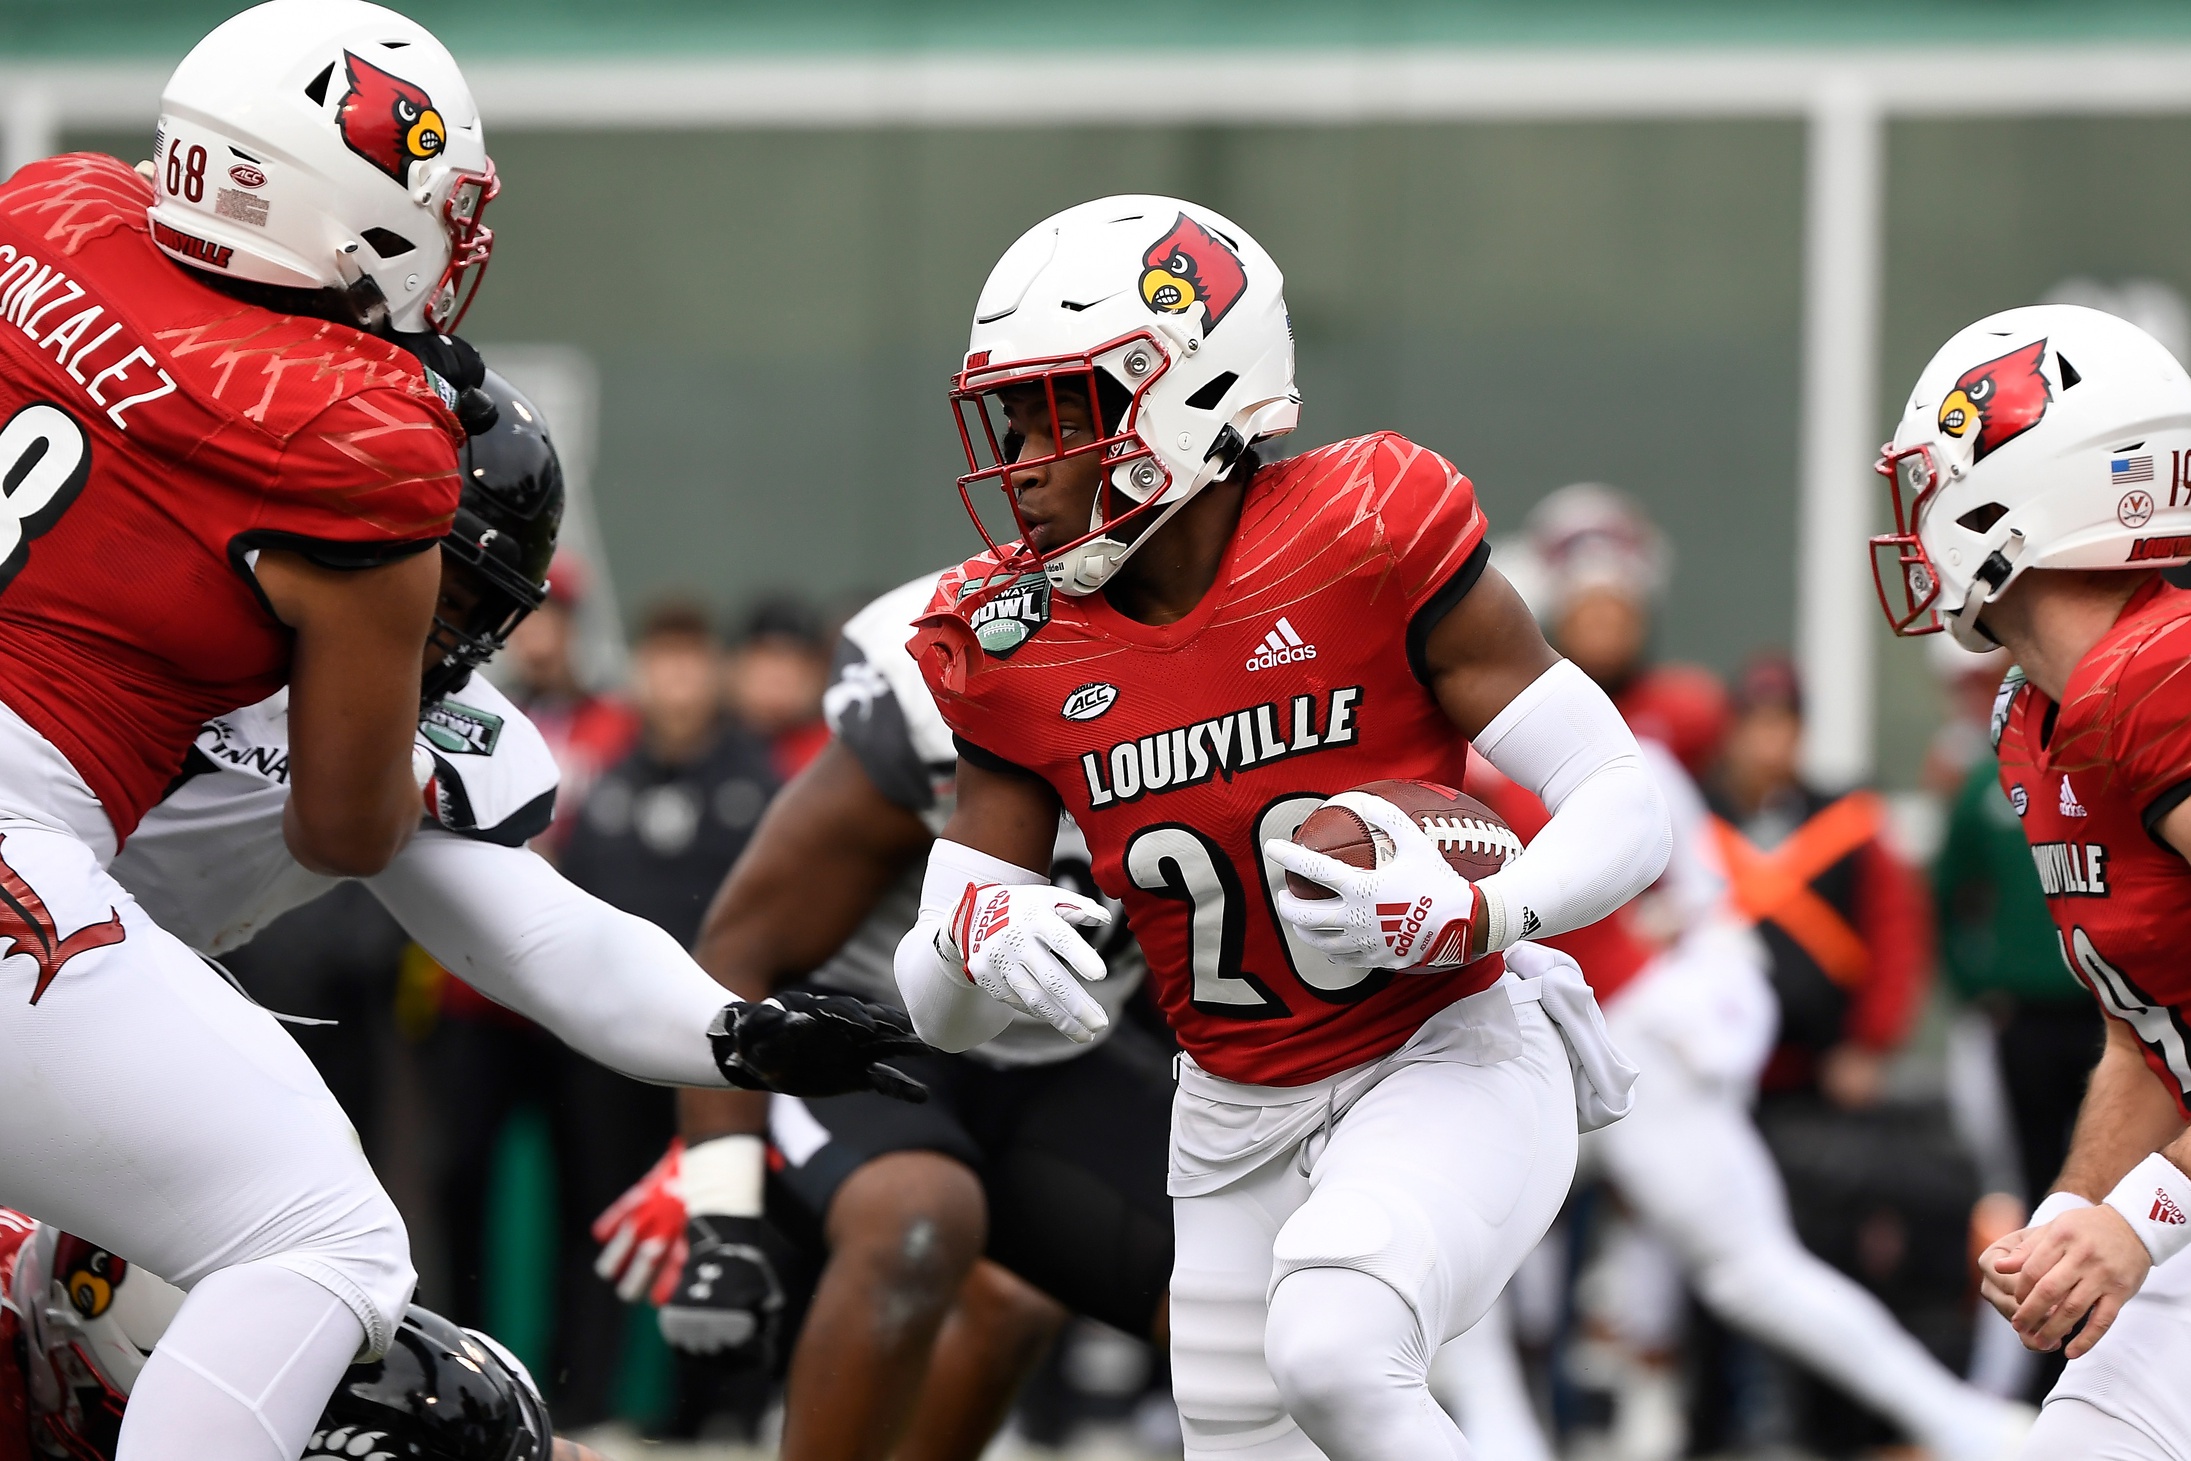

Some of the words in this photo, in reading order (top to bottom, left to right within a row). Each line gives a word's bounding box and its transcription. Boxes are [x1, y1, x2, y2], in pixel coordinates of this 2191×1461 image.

[166, 138, 208, 203] 68
[1246, 643, 1317, 672] adidas
[1068, 685, 1111, 714] ACC
[1081, 685, 1363, 810] LOUISVILLE
[972, 890, 1009, 954] adidas
[1394, 895, 1433, 957] adidas
[2155, 1187, 2187, 1225] adidas
